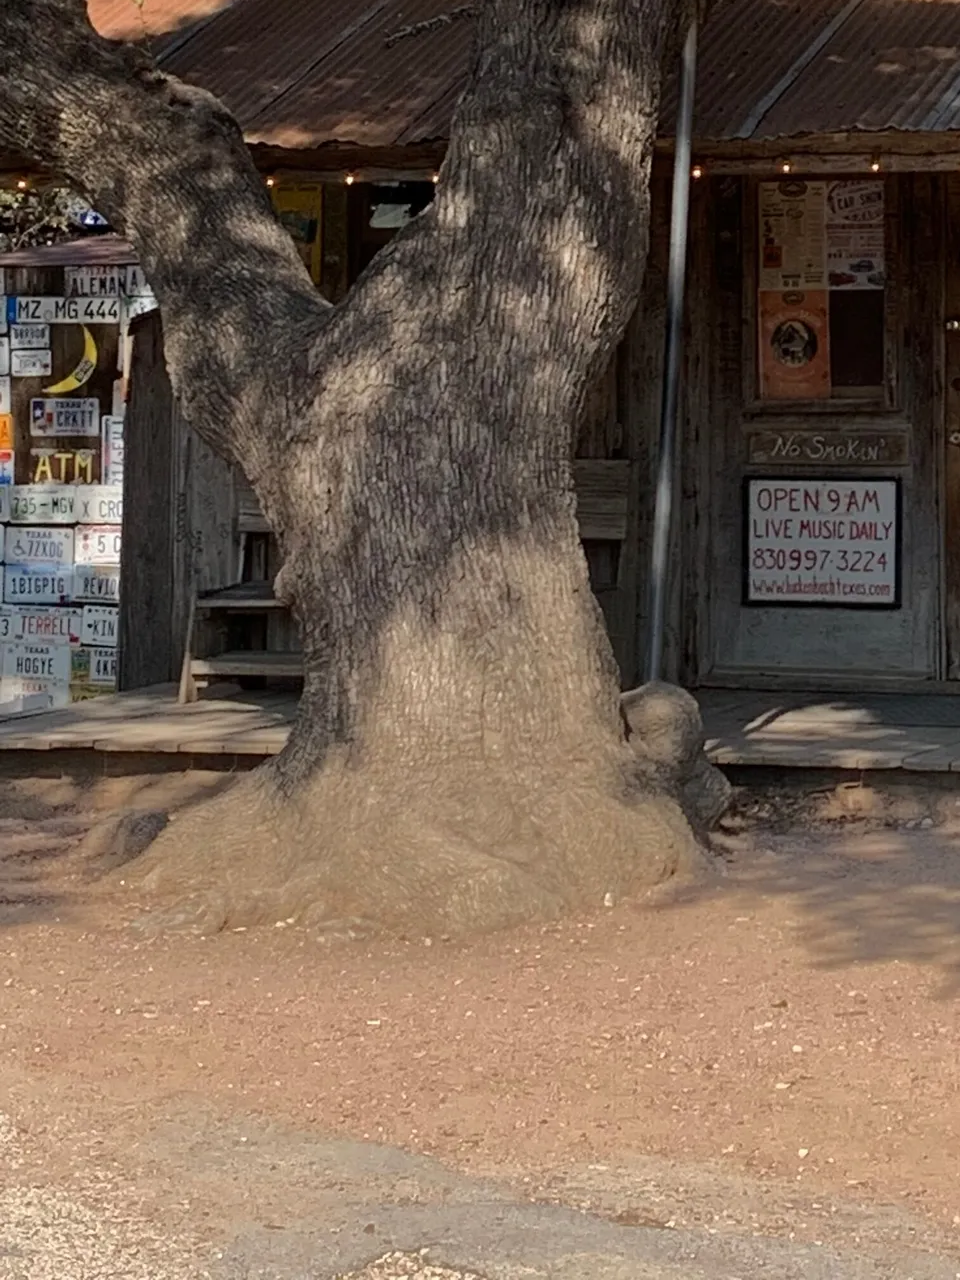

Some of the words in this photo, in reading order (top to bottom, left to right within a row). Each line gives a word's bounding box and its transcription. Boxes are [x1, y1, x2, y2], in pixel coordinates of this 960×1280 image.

[70, 276, 127, 295] ALEMAN
[18, 300, 42, 319] MZ
[55, 300, 78, 319] MG
[84, 300, 118, 319] 444
[34, 453, 93, 483] ATM
[757, 488, 820, 512] OPEN
[753, 519, 793, 539] LIVE
[799, 520, 845, 540] MUSIC
[849, 521, 893, 541] DAILY
[16, 657, 54, 675] HOGYE
